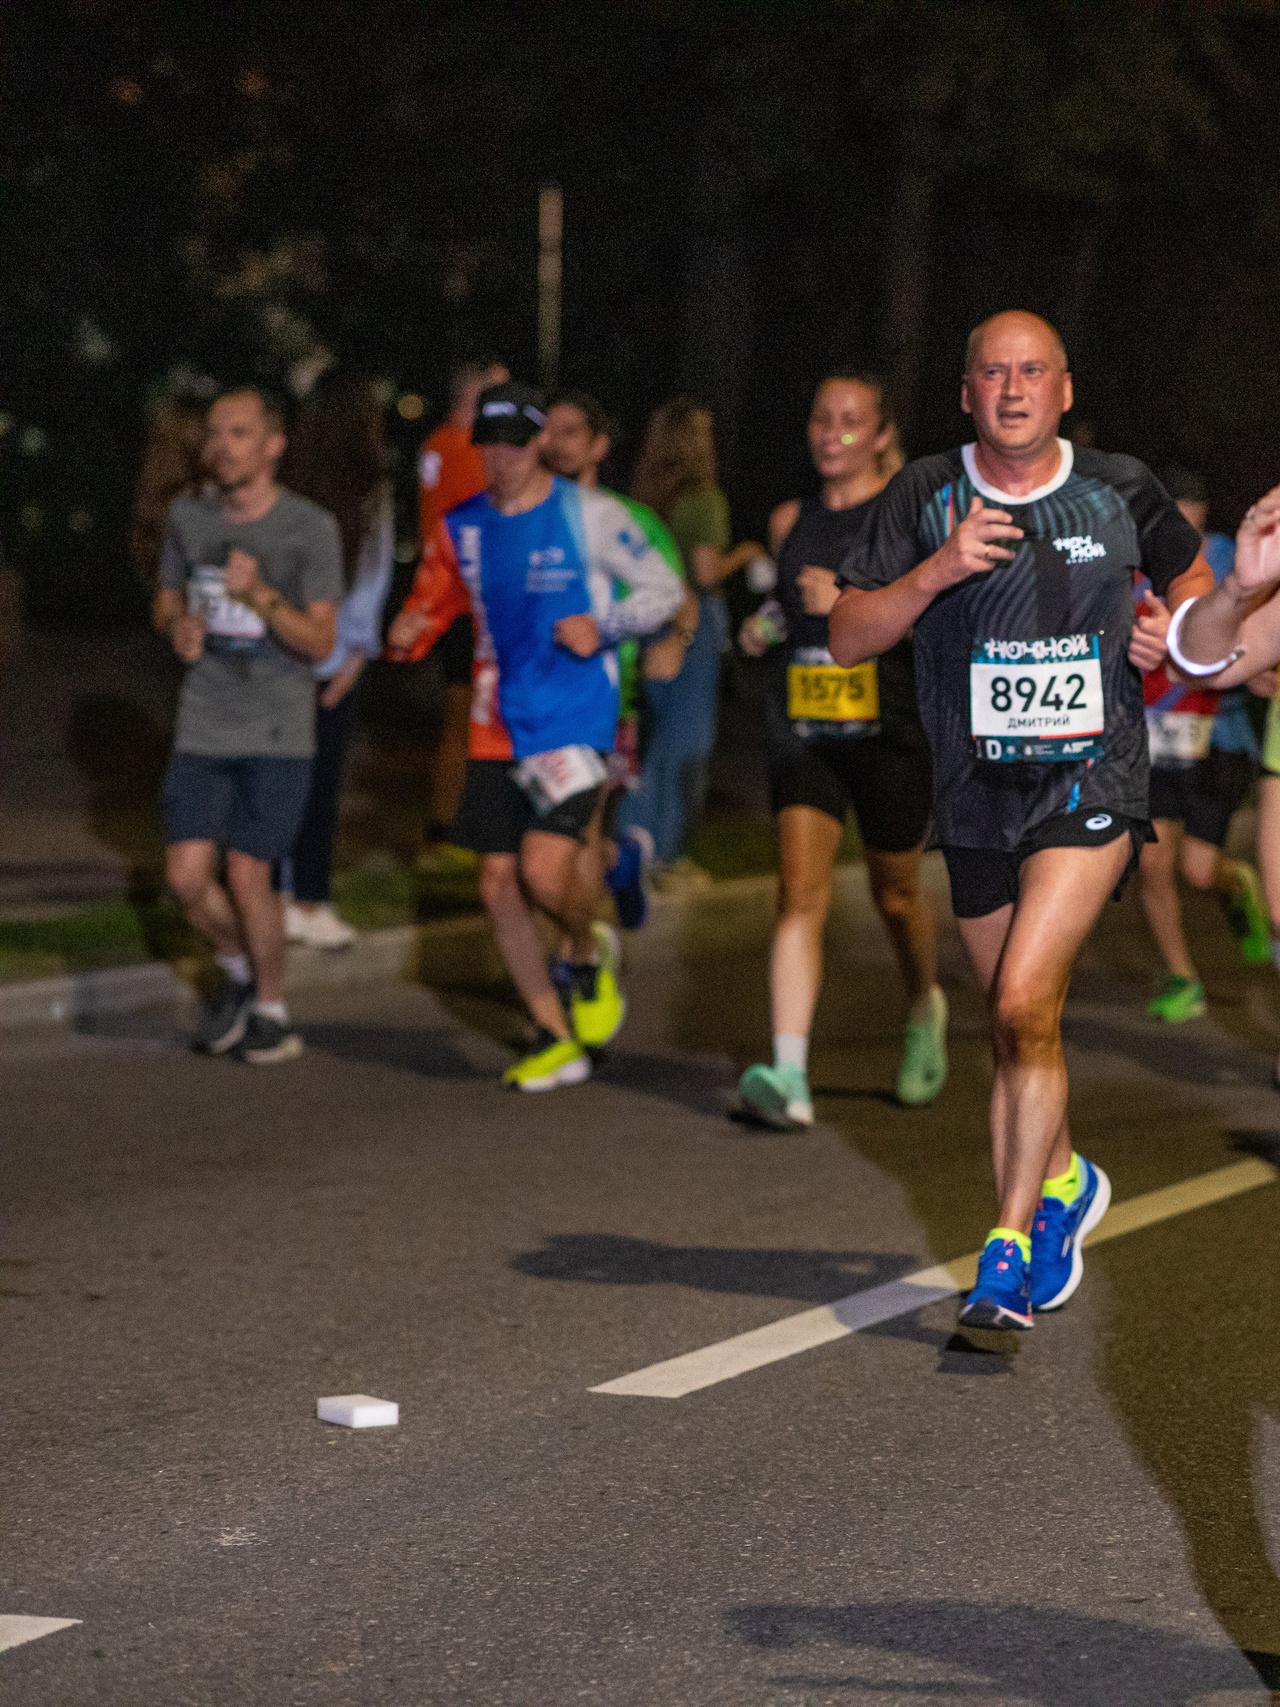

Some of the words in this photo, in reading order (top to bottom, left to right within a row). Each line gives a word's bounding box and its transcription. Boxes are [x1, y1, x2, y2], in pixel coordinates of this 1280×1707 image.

[801, 672, 865, 702] 1575
[991, 673, 1087, 712] 8942
[1007, 714, 1070, 729] ДМИТРИЙ
[985, 739, 1002, 760] D
